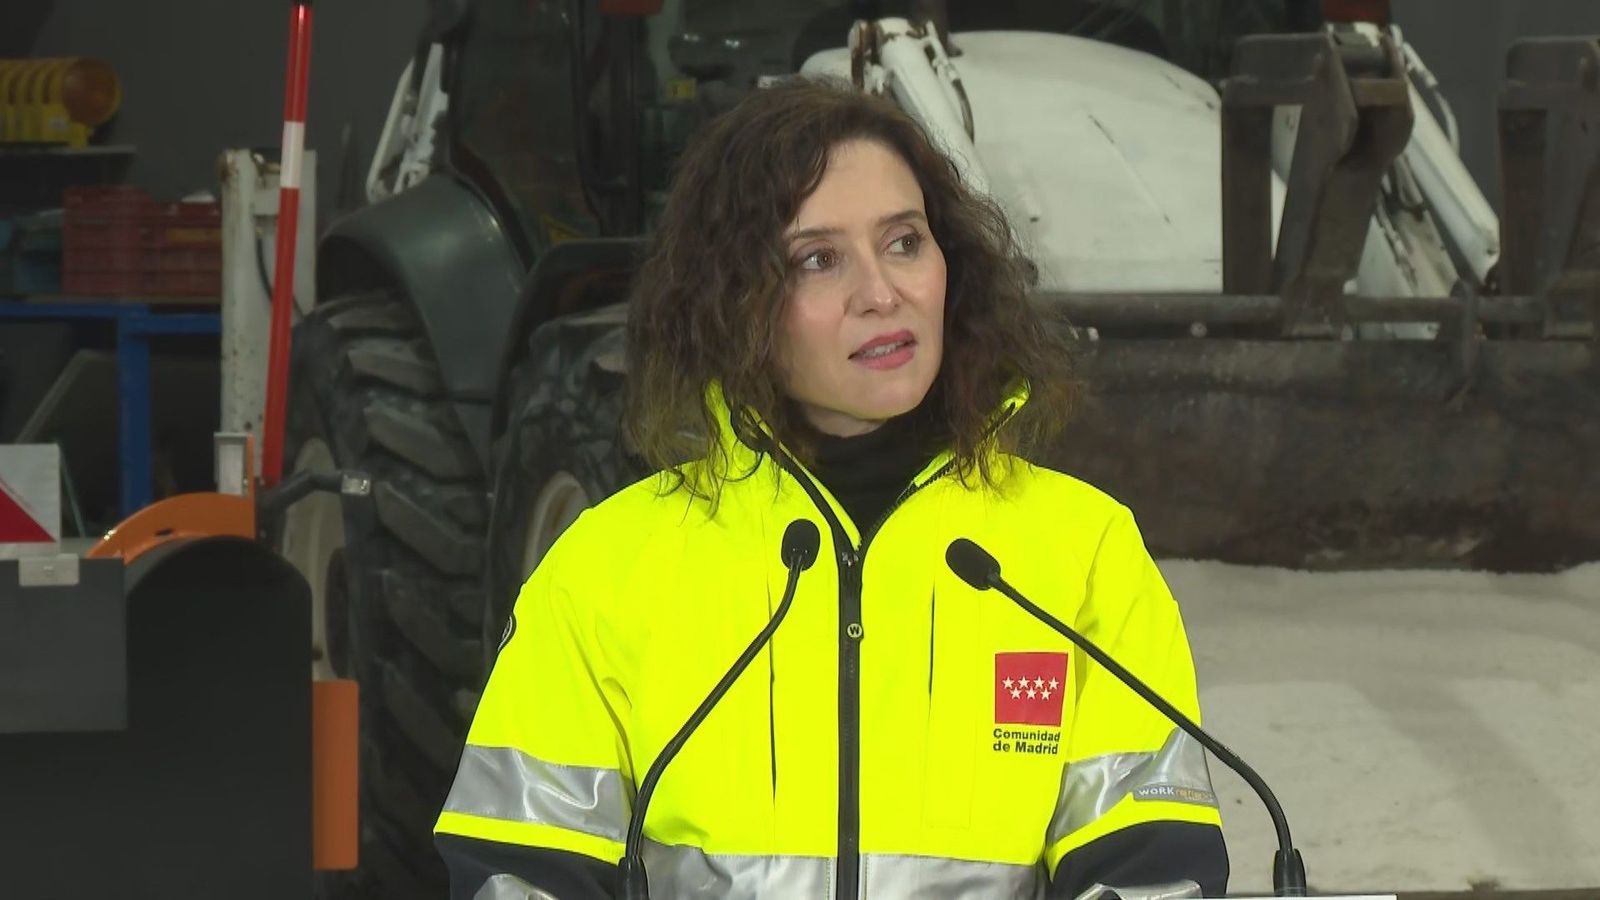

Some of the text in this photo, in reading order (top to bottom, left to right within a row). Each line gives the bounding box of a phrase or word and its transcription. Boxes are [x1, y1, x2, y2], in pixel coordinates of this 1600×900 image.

[849, 625, 860, 636] W
[993, 728, 1061, 743] Comunidad
[993, 740, 1059, 755] de Madrid
